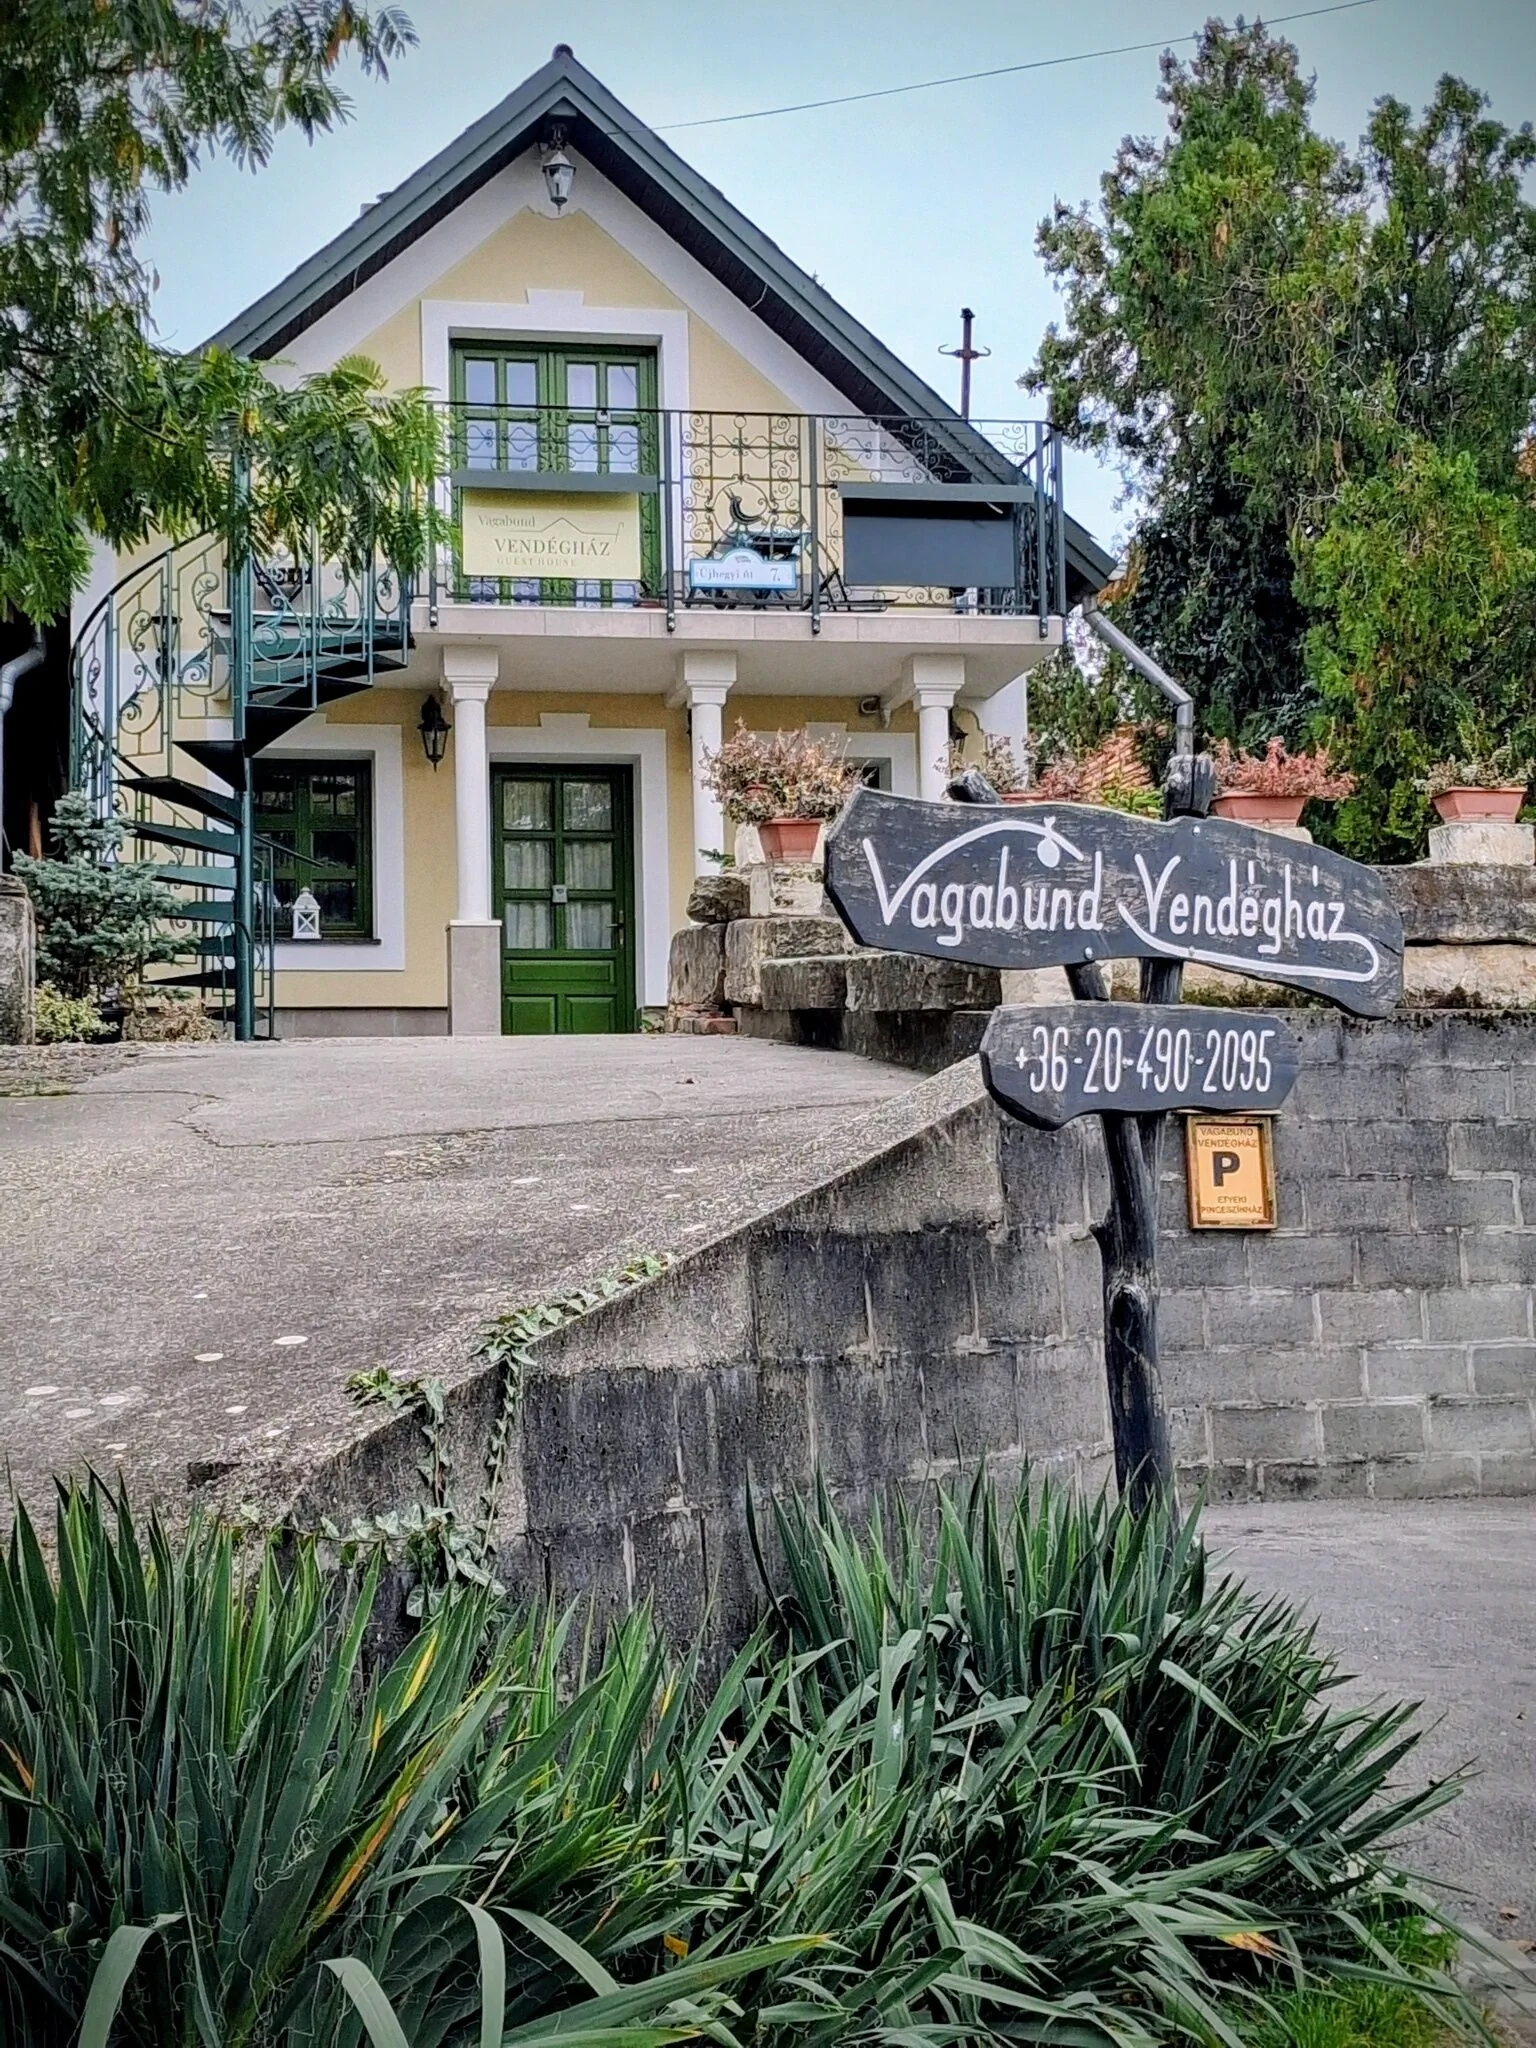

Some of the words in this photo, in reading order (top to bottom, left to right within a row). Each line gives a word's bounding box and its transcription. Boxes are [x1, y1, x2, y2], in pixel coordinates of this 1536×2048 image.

[478, 514, 536, 528] Vagabund
[494, 536, 611, 557] VENDÉGHÁZ
[496, 556, 534, 566] GUEST
[538, 557, 577, 567] HOUSE
[862, 818, 1103, 948] Vagabund
[1117, 853, 1380, 983] Vendégház
[1015, 1025, 1276, 1094] +36-20-490-2095
[1200, 1127, 1254, 1137] VAGABUND
[1198, 1137, 1259, 1148] VENDÉGHÁZ
[1211, 1150, 1241, 1188] P
